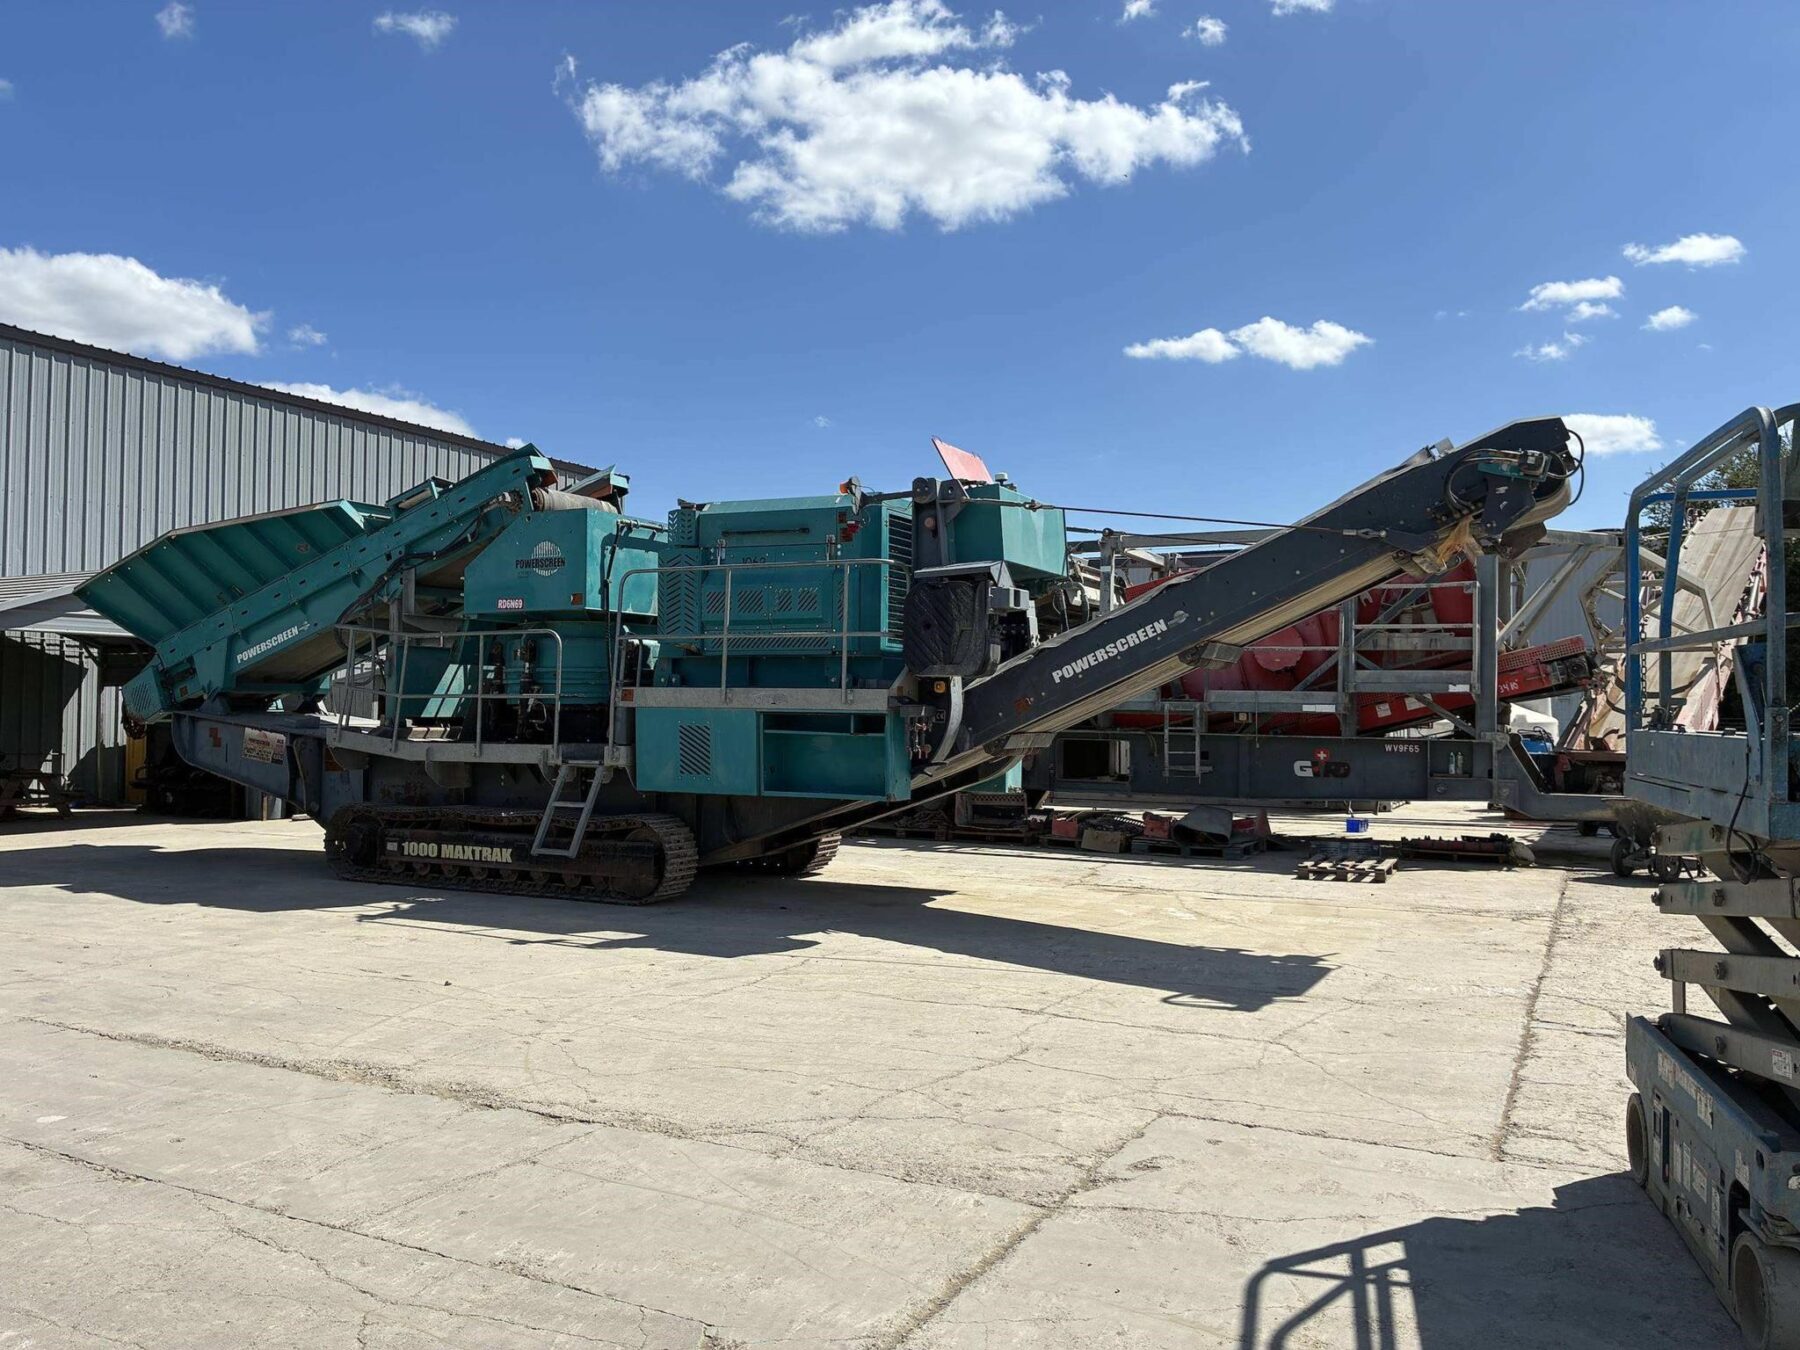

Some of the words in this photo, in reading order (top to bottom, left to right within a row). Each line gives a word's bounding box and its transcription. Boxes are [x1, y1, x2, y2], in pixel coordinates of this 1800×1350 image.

[516, 556, 565, 569] POWERSCREEN
[236, 625, 299, 664] POWERSCREEN
[1052, 618, 1168, 684] POWERSCREEN
[1384, 743, 1420, 753] WV9F65
[401, 841, 438, 858] 1000
[441, 843, 513, 863] MAXTRAK
